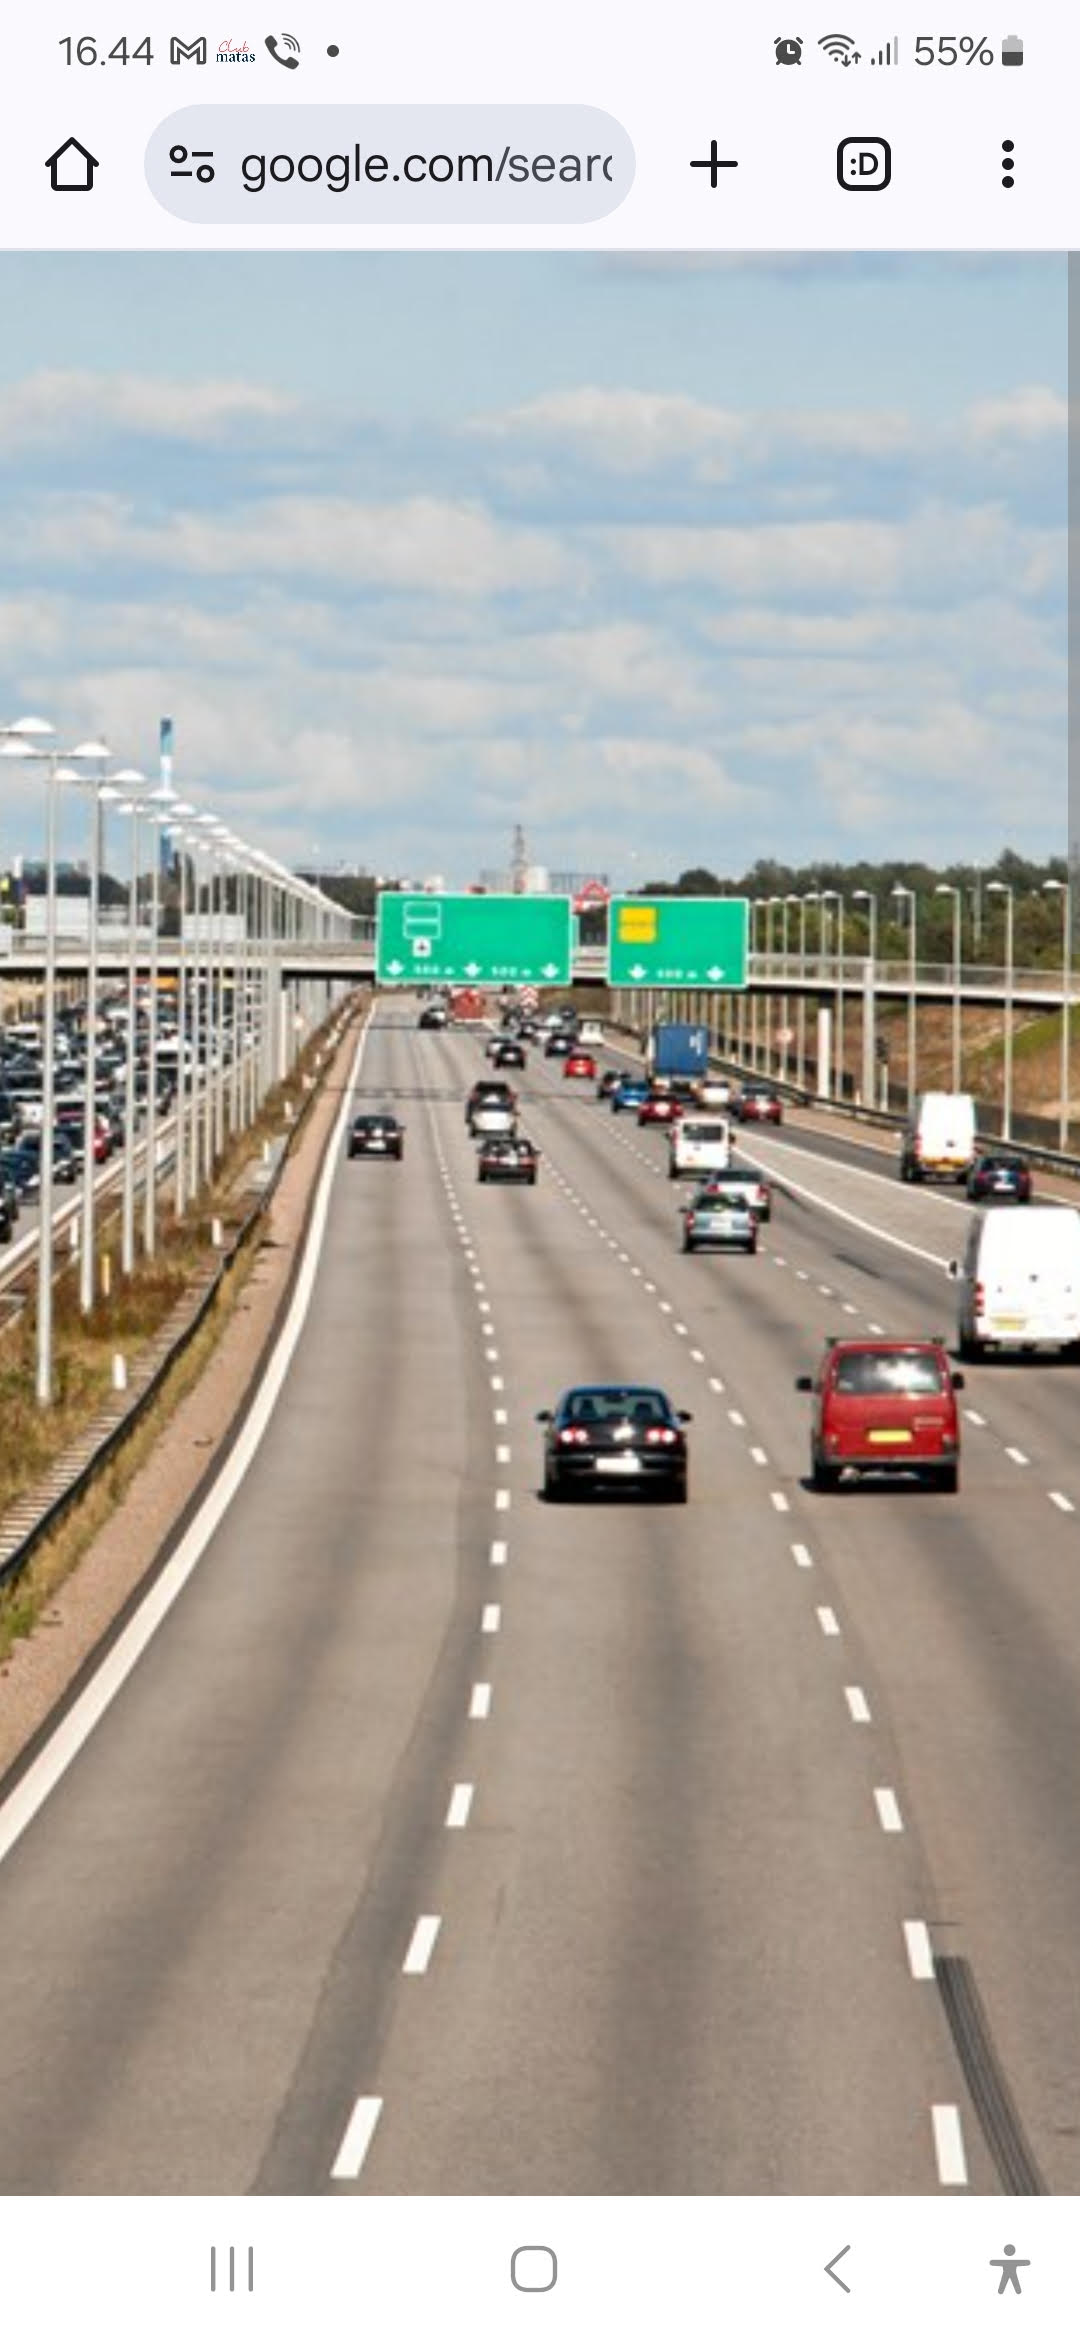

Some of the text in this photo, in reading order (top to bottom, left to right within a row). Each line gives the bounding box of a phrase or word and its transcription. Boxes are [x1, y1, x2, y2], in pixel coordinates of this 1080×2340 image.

[58, 36, 154, 66] 16.44
[218, 38, 250, 53] Club
[914, 36, 994, 66] 55%
[216, 51, 256, 63] matas
